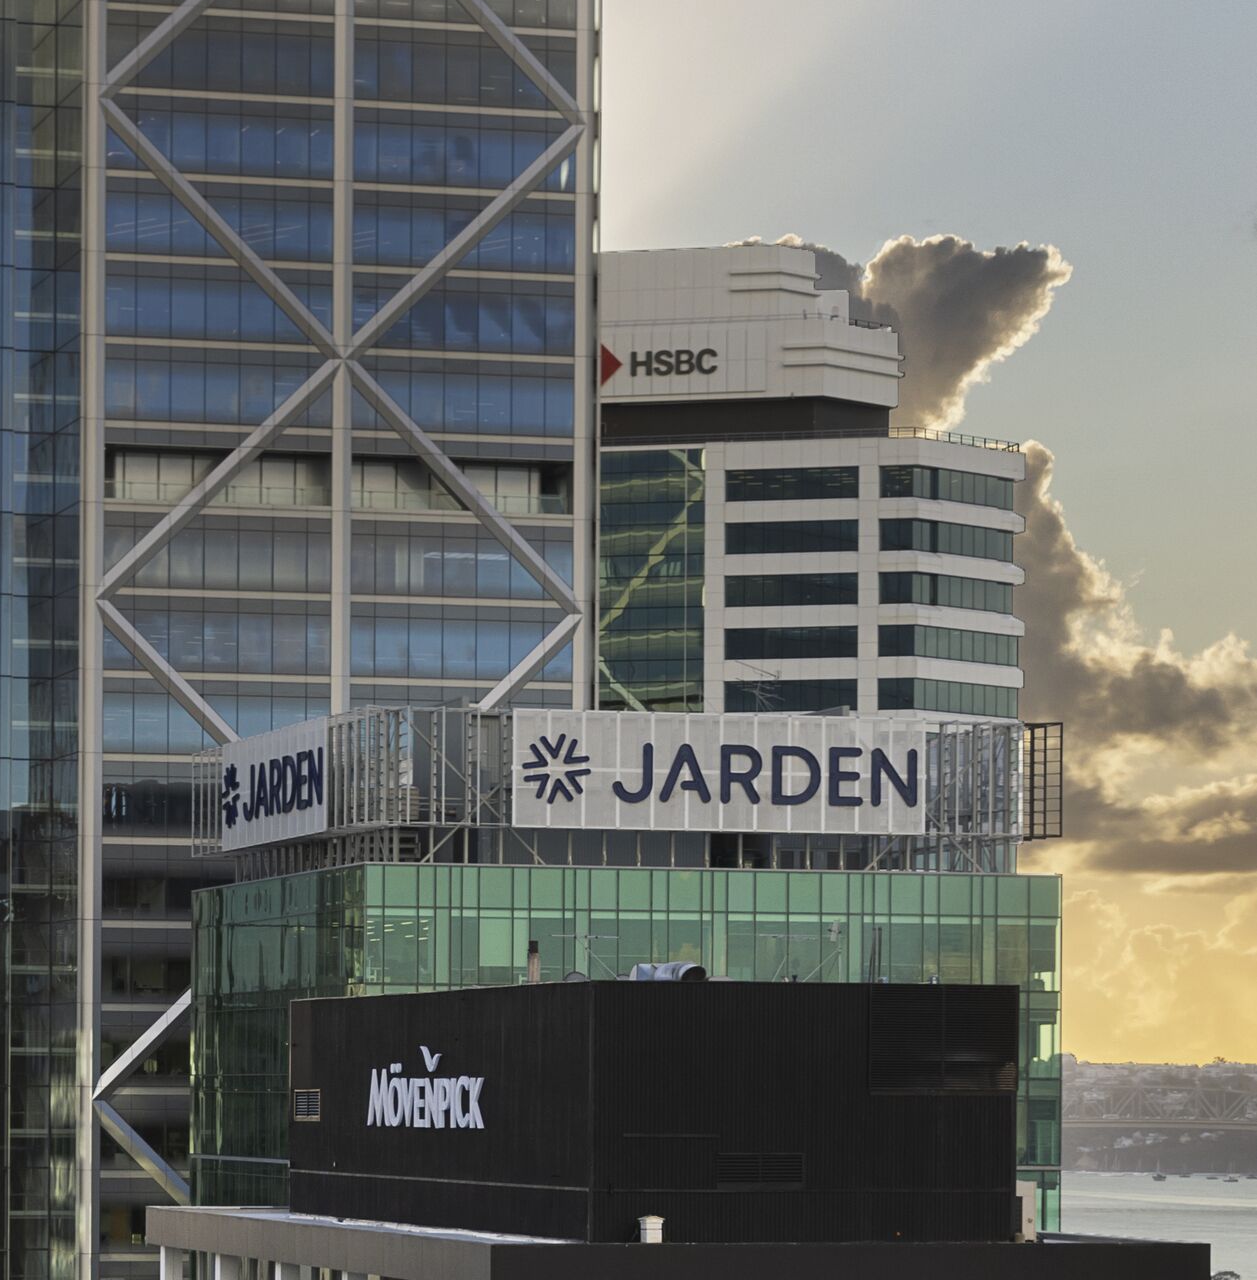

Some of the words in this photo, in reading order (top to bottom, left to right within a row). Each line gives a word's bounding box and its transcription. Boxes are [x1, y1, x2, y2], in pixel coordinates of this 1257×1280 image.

[630, 348, 718, 377] HSBC
[243, 746, 324, 822] JARDEN
[612, 742, 918, 807] JARDEN
